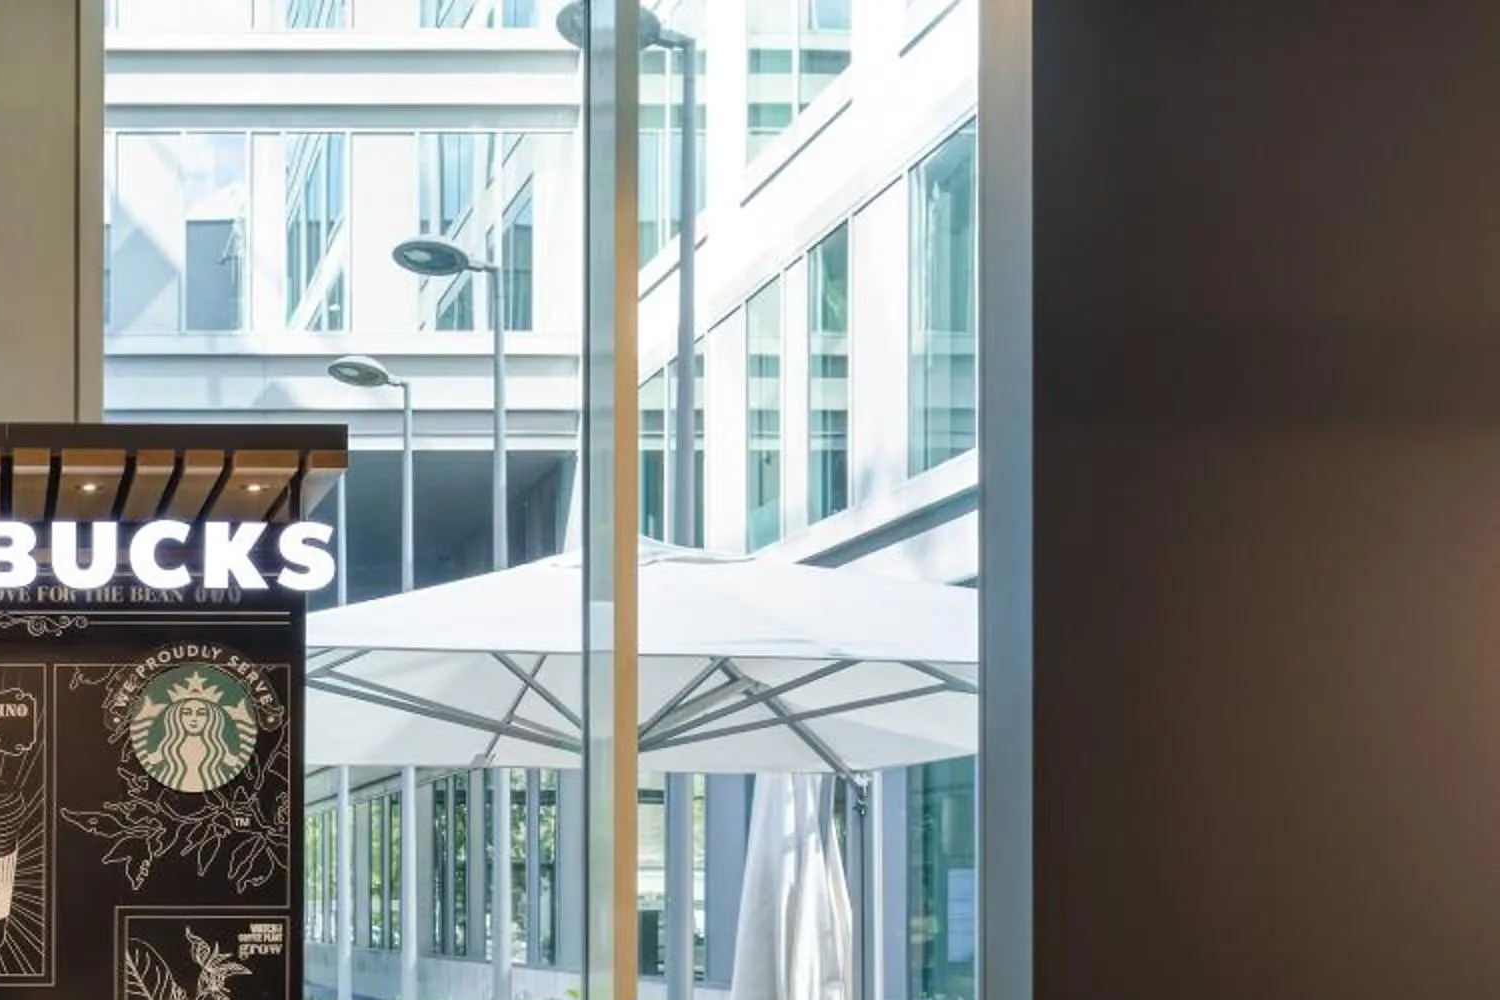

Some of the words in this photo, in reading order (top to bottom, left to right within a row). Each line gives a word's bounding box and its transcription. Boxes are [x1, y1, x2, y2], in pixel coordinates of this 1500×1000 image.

[114, 678, 137, 708] WE
[135, 644, 223, 679] PROUDLY
[227, 655, 274, 705] SERVE
[239, 943, 283, 961] grow
